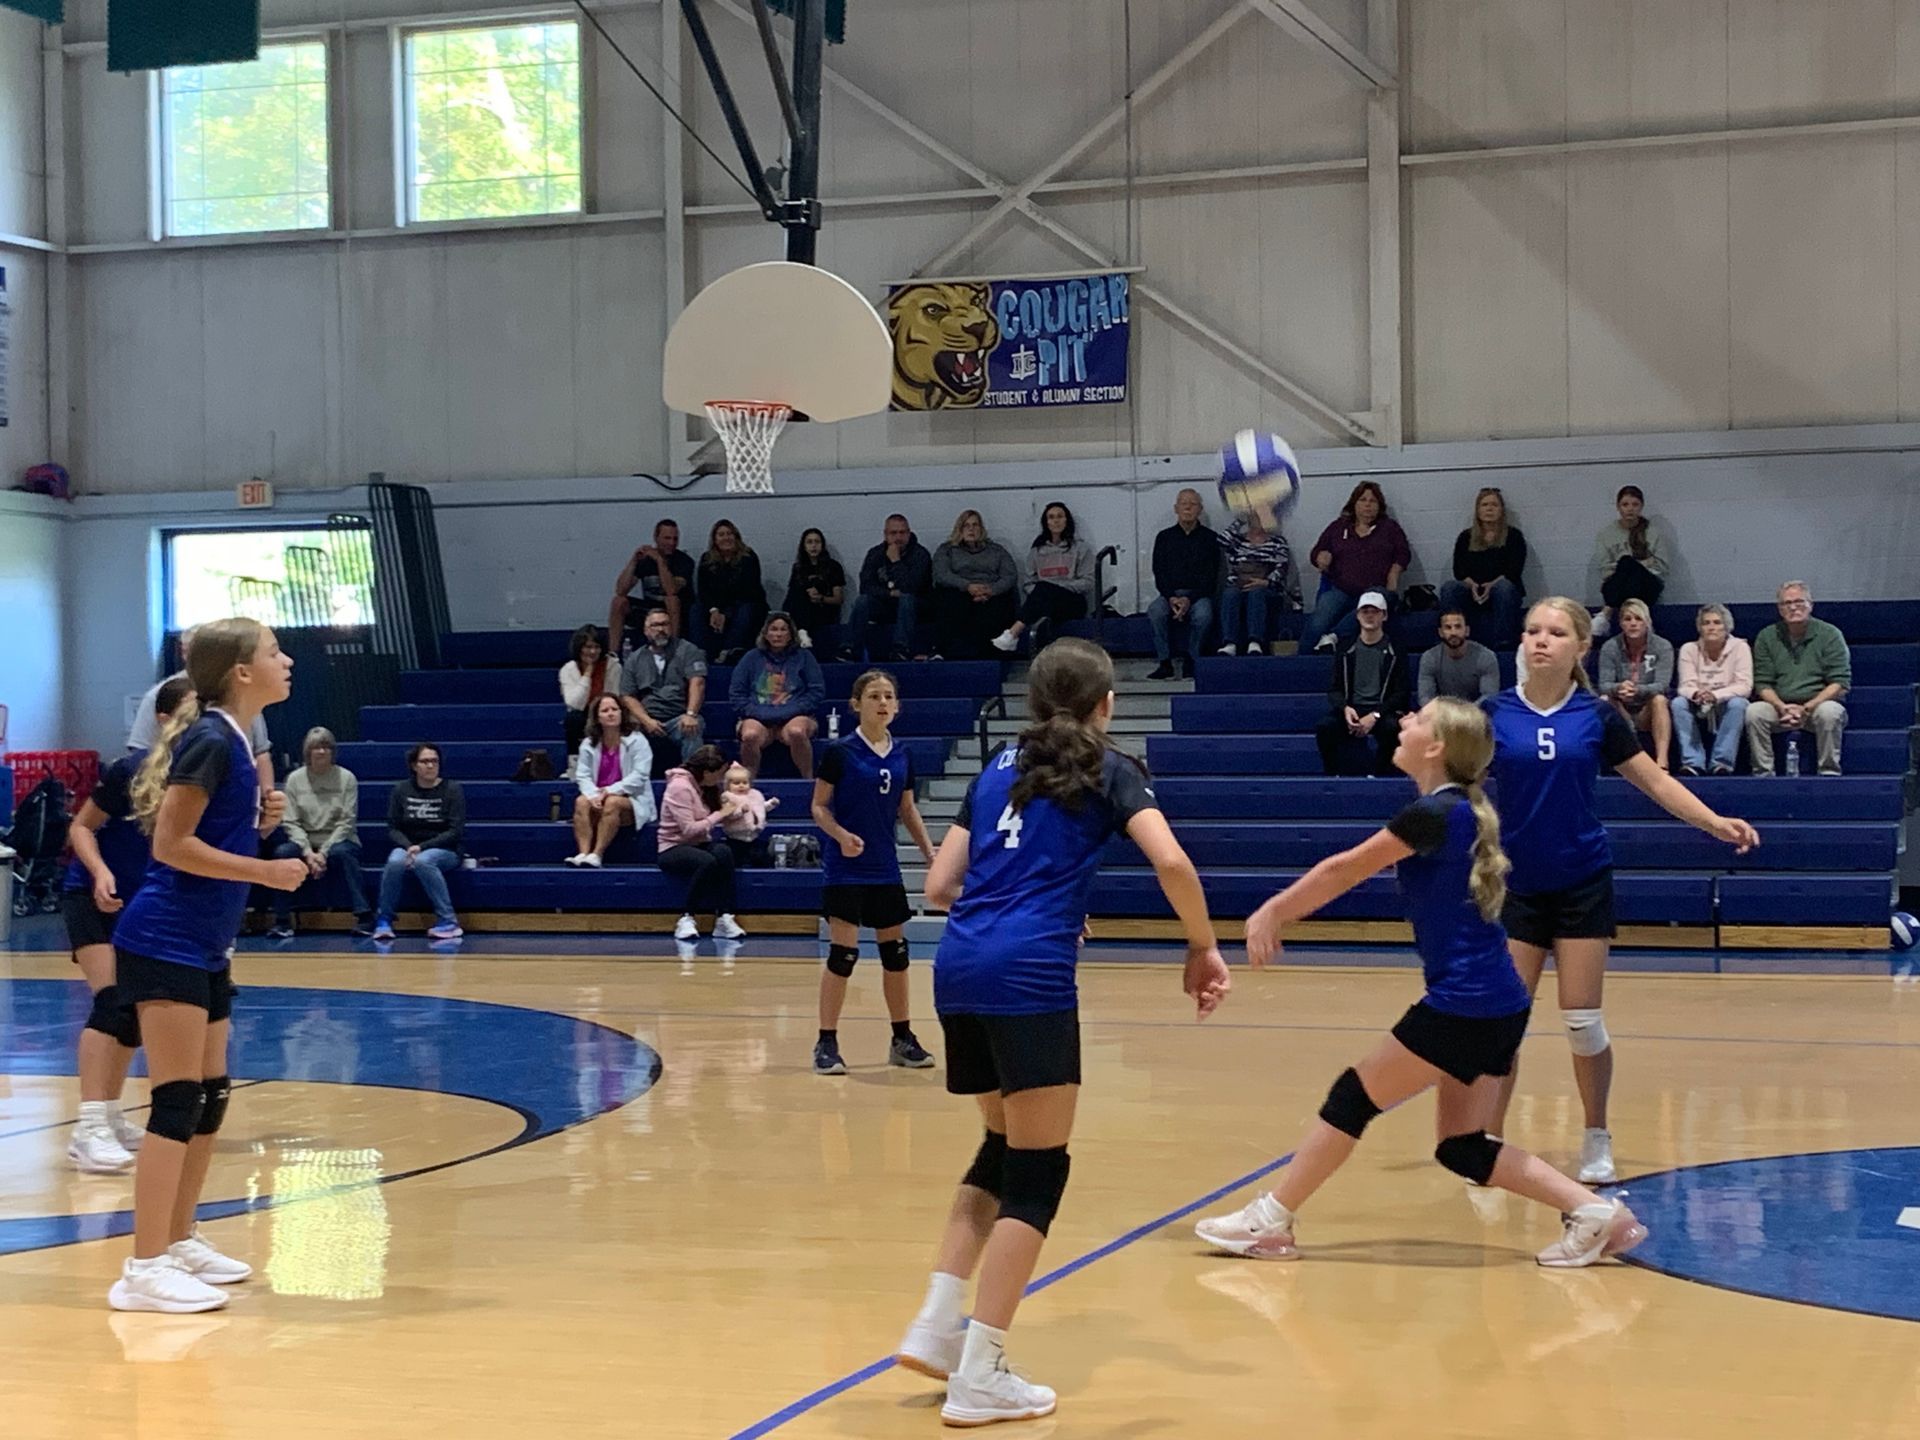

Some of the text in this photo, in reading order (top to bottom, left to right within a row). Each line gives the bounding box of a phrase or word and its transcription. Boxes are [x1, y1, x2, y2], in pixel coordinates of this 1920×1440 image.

[999, 273, 1129, 340] COUGAR
[1037, 331, 1093, 386] PIT
[984, 385, 1125, 406] STUDENT & ALUMNI SECTION
[1537, 727, 1556, 760] 5
[879, 768, 892, 794] 3
[997, 800, 1023, 848] 4
